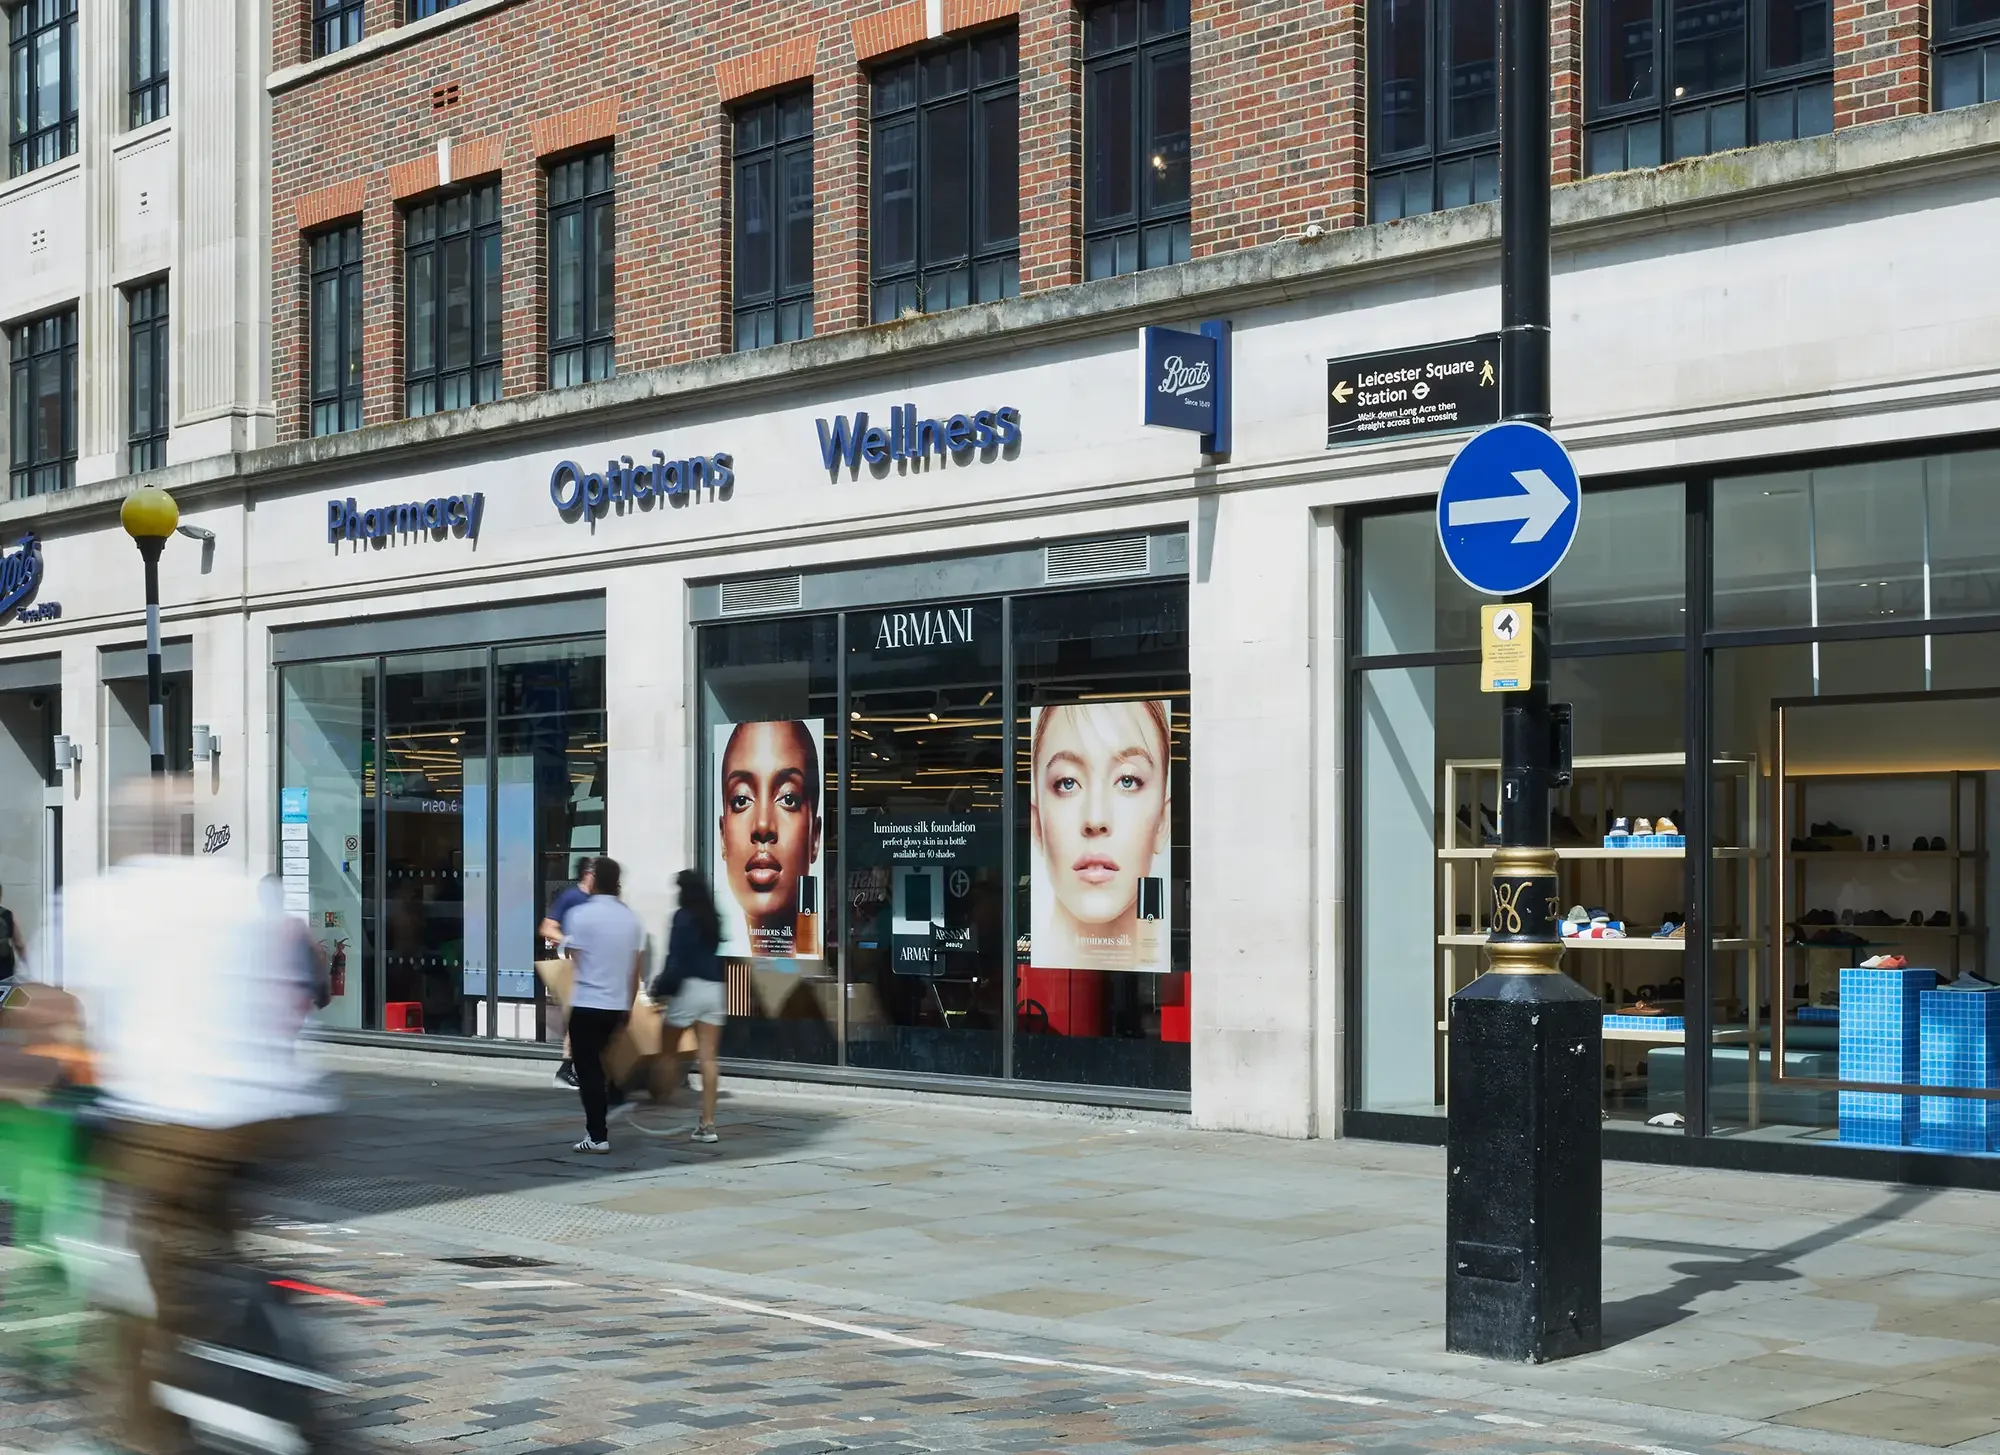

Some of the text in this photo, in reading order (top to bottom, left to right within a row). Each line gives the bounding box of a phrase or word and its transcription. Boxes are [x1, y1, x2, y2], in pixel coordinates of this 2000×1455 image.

[1158, 355, 1211, 396] Boots
[1357, 360, 1475, 388] Leicester Square
[1184, 397, 1198, 406] Since
[1357, 387, 1407, 407] Station
[1357, 402, 1457, 422] Walk down Long Acre then
[1357, 412, 1458, 432] straight across the crossing
[815, 402, 1020, 470] Wellness
[550, 449, 734, 523] Opticians
[327, 492, 485, 544] Pharmacy
[874, 607, 974, 649] ARMANI
[1505, 782, 1512, 799] 1
[873, 820, 976, 834] luminous silk foundation
[202, 823, 231, 854] Boots
[882, 836, 967, 849] perfect glowy skin in a bottle
[892, 849, 919, 859] available
[919, 850, 926, 858] in
[935, 849, 956, 859] shades
[749, 924, 794, 937] luminous silk
